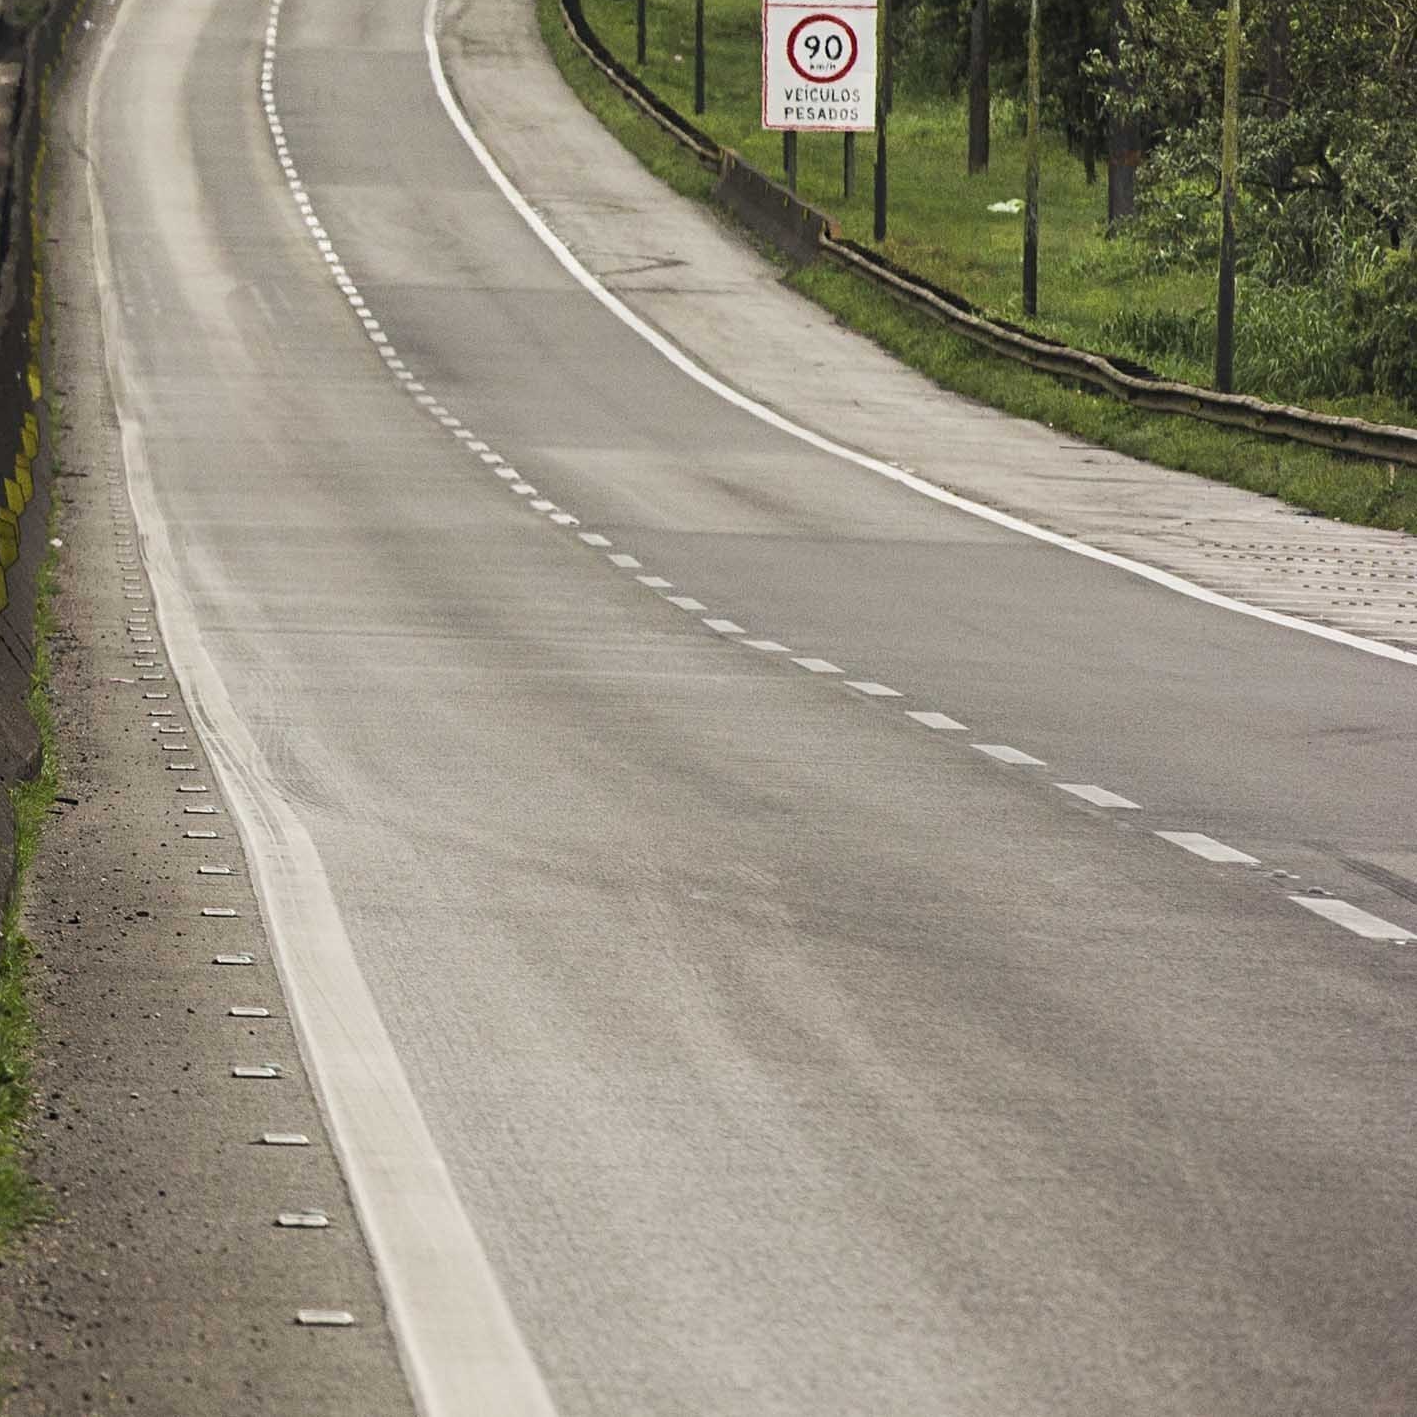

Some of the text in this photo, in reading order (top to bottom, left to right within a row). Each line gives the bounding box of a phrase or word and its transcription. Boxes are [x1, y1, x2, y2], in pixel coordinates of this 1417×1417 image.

[804, 34, 843, 61] 90
[784, 84, 861, 103] VEÍCULOS
[784, 107, 860, 122] PESADOS
